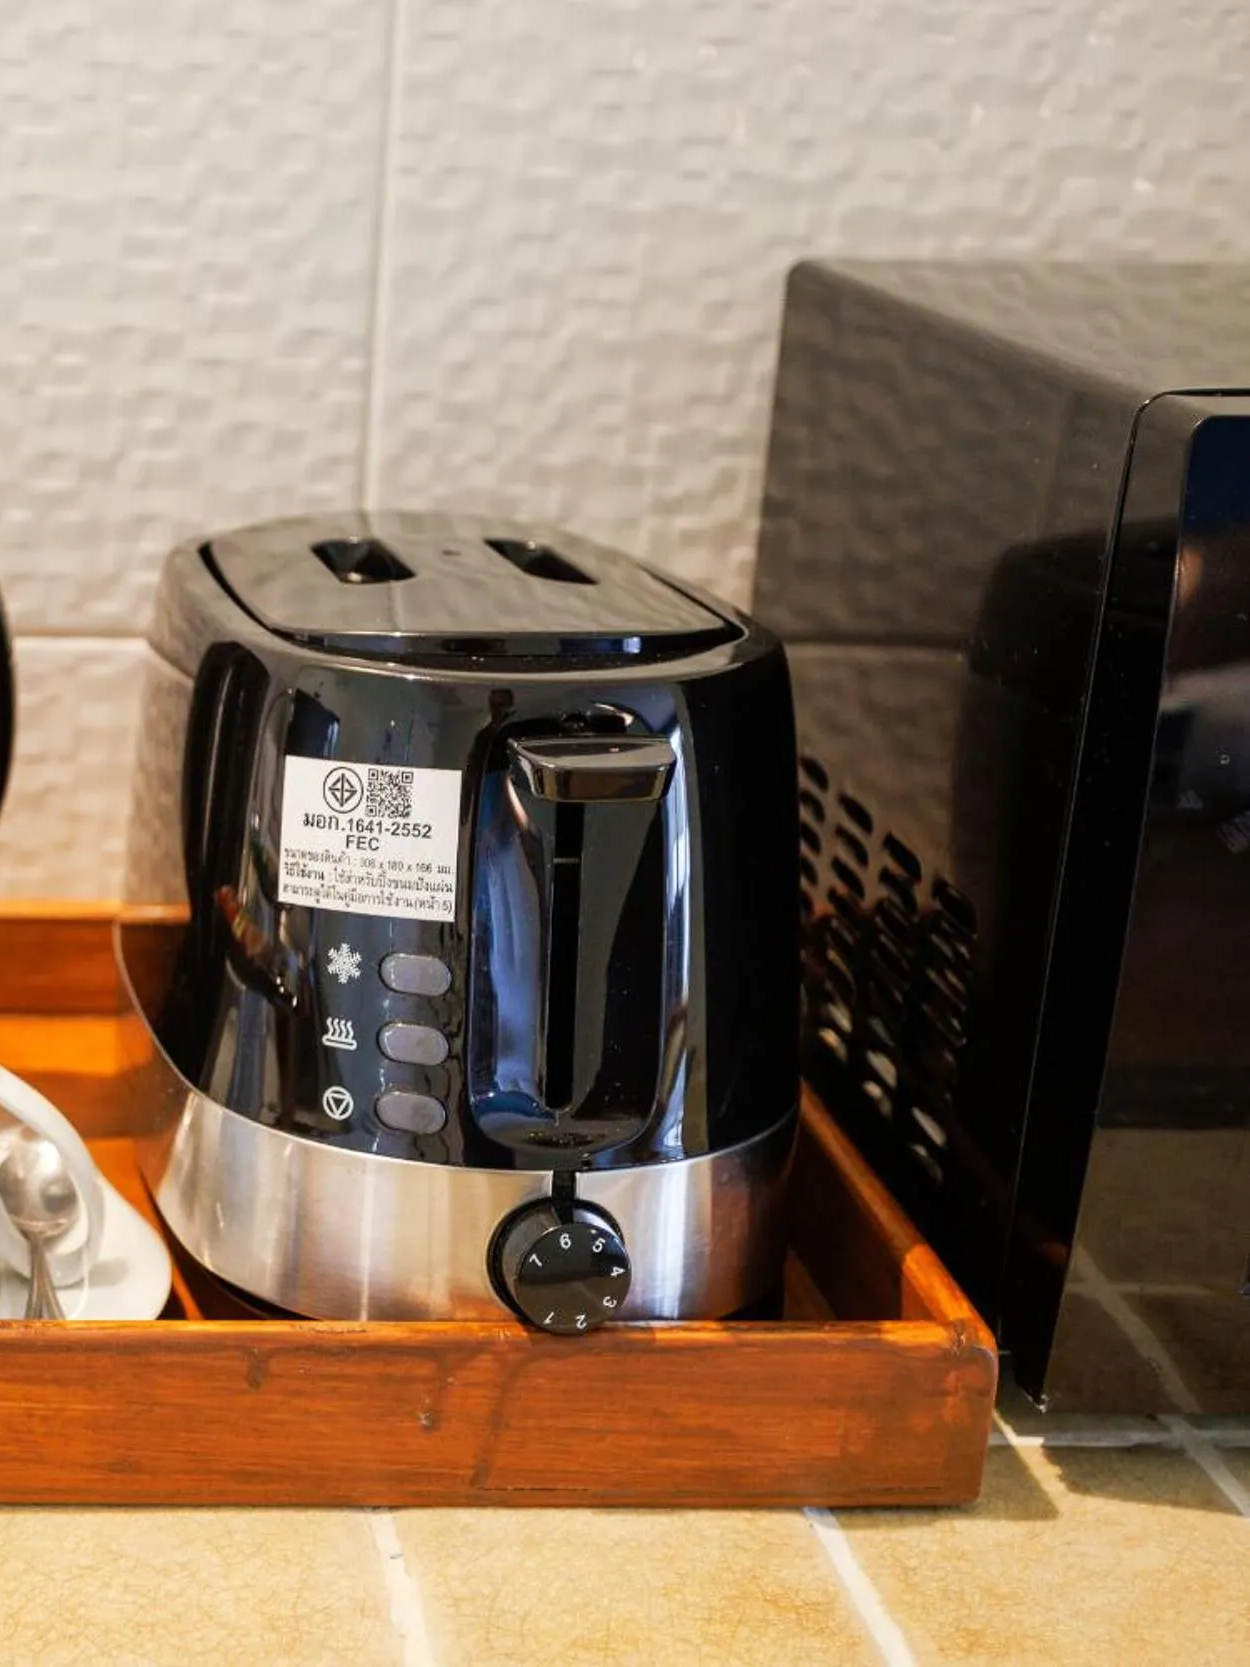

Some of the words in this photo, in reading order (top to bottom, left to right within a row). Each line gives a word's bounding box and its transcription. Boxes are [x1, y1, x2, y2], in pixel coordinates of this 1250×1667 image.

[303, 813, 432, 839] มอก.1641-2552
[345, 835, 380, 851] FEC
[559, 1233, 572, 1249] 6
[592, 1238, 606, 1253] 5
[529, 1254, 543, 1267] 7
[610, 1266, 626, 1277] 4
[603, 1296, 617, 1308] 3
[575, 1314, 587, 1329] 2
